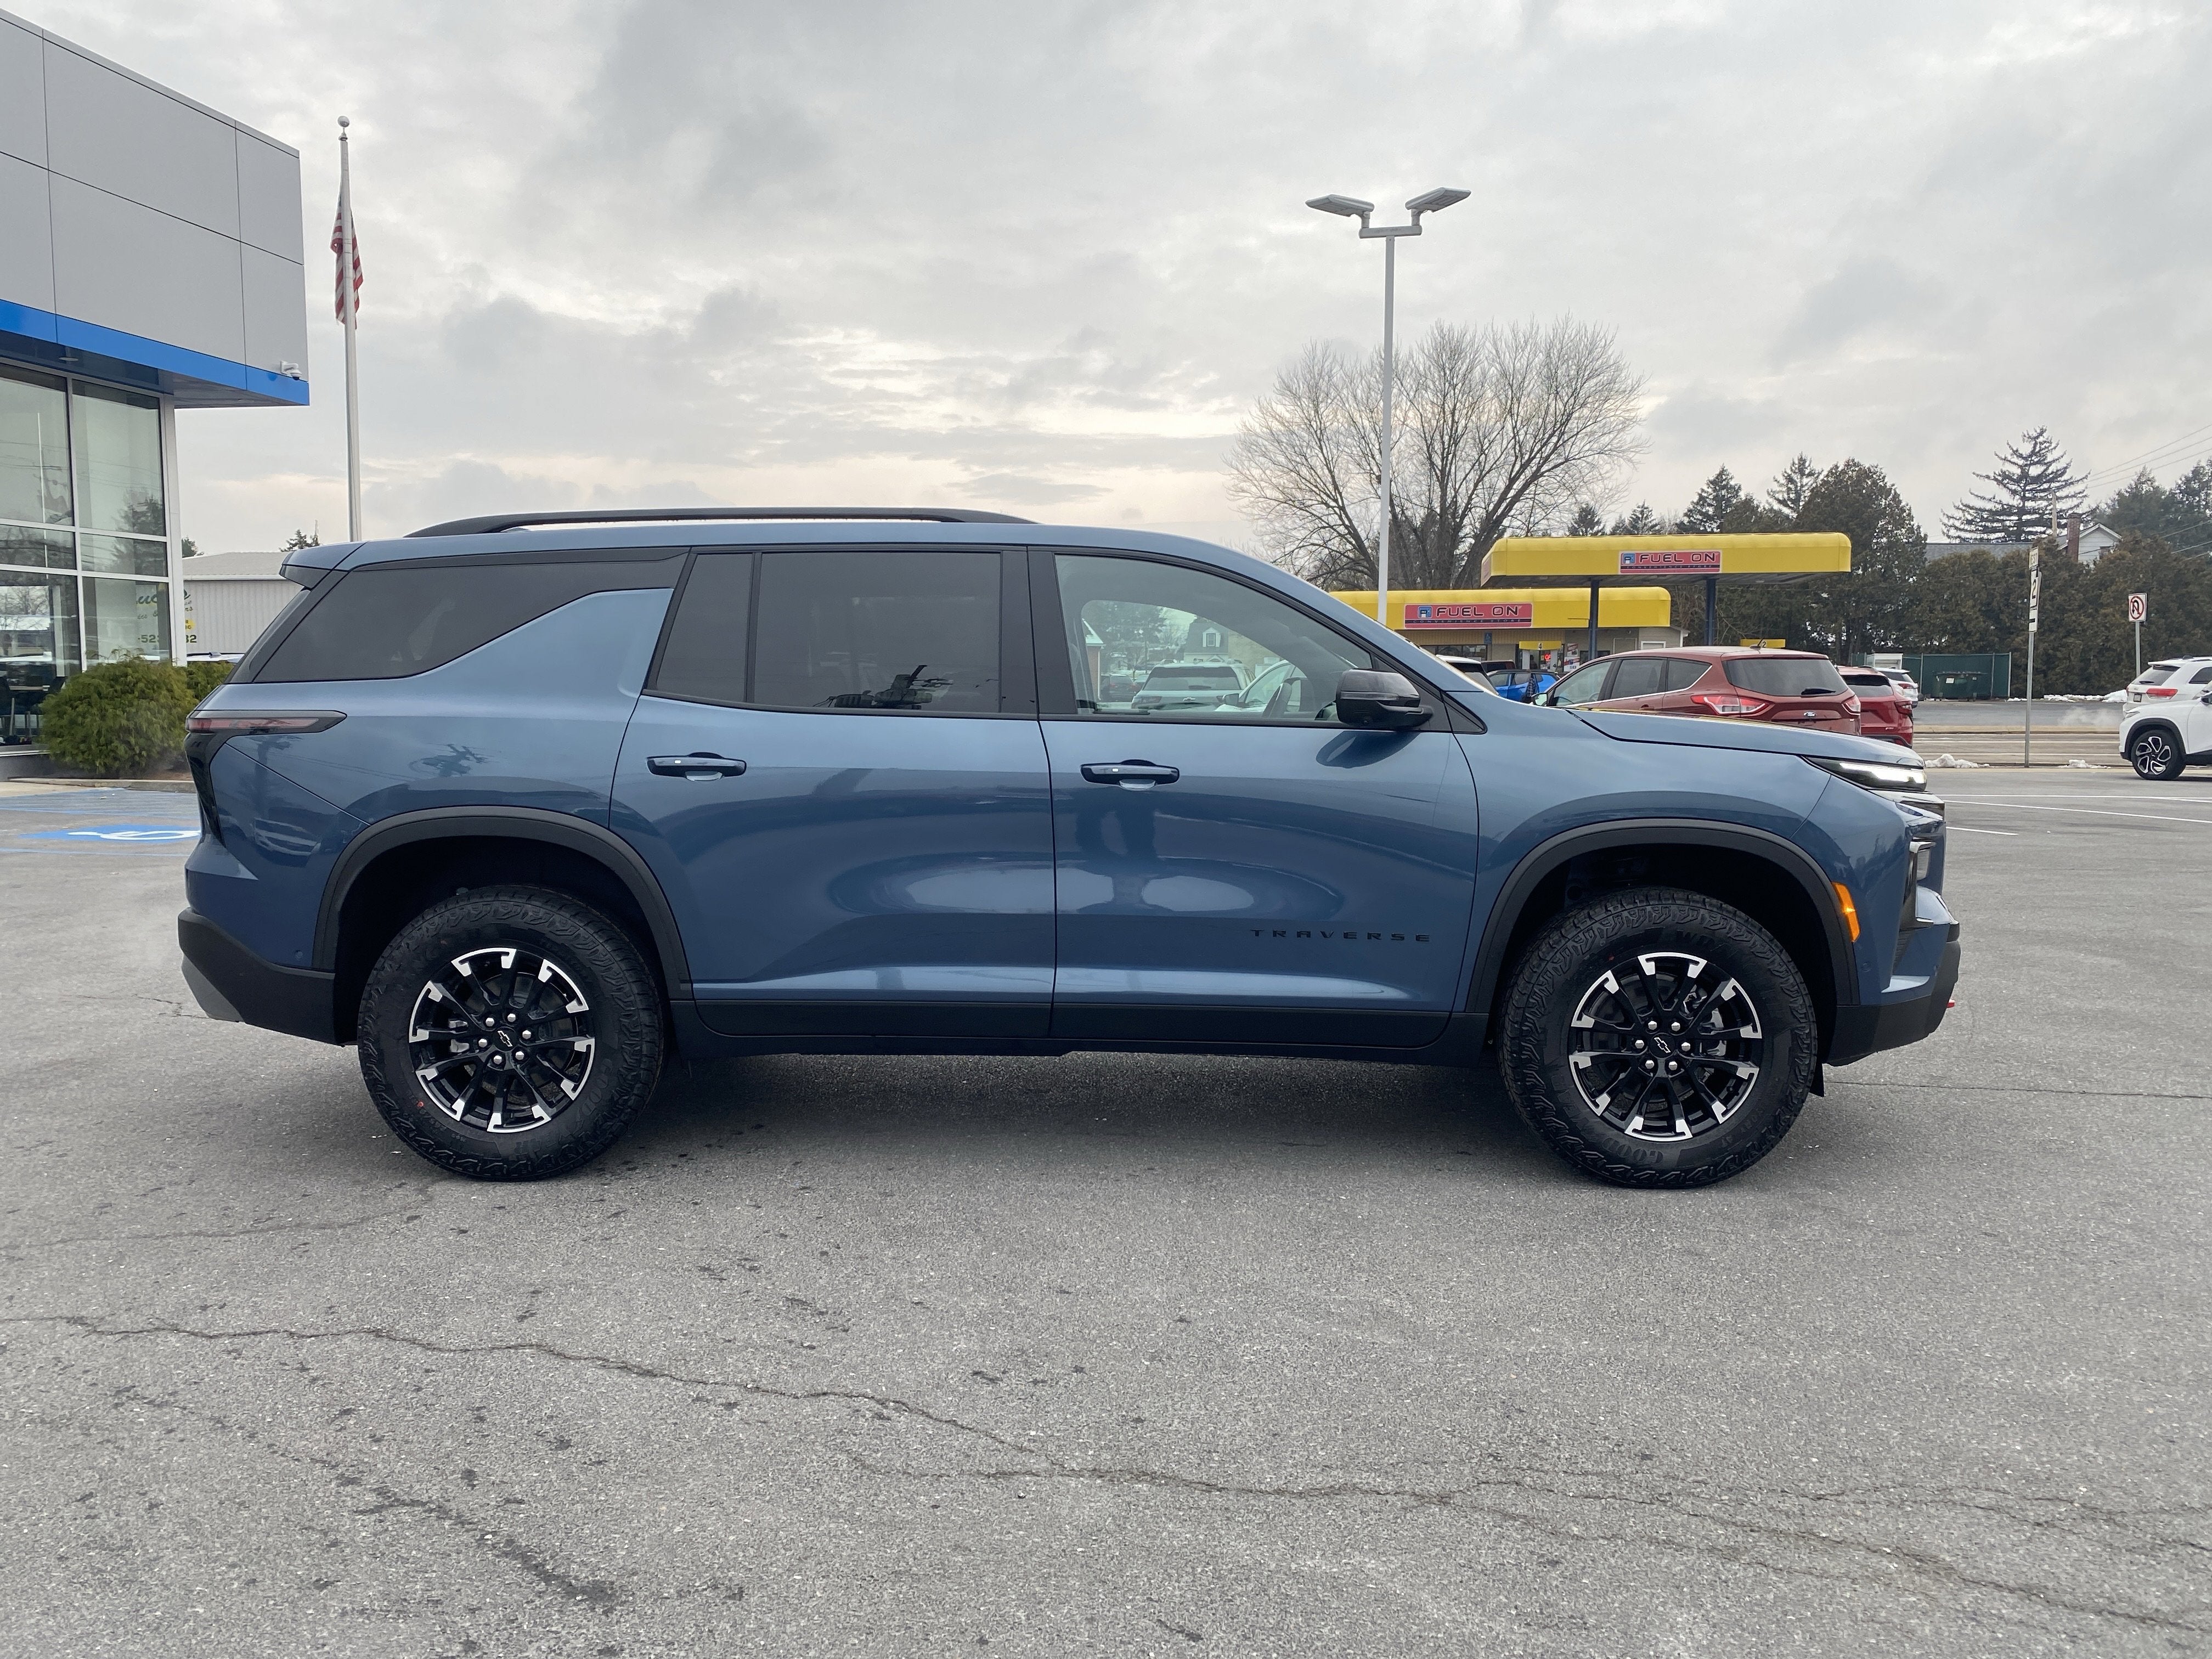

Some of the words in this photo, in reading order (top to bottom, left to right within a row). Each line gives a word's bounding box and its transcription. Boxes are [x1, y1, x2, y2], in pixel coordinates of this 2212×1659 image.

[1639, 553, 1683, 563] FUEL
[1691, 552, 1716, 562] ON
[1436, 606, 1484, 617] FUEL
[1492, 606, 1519, 616] ON
[1250, 929, 1430, 942] TRAVERSE
